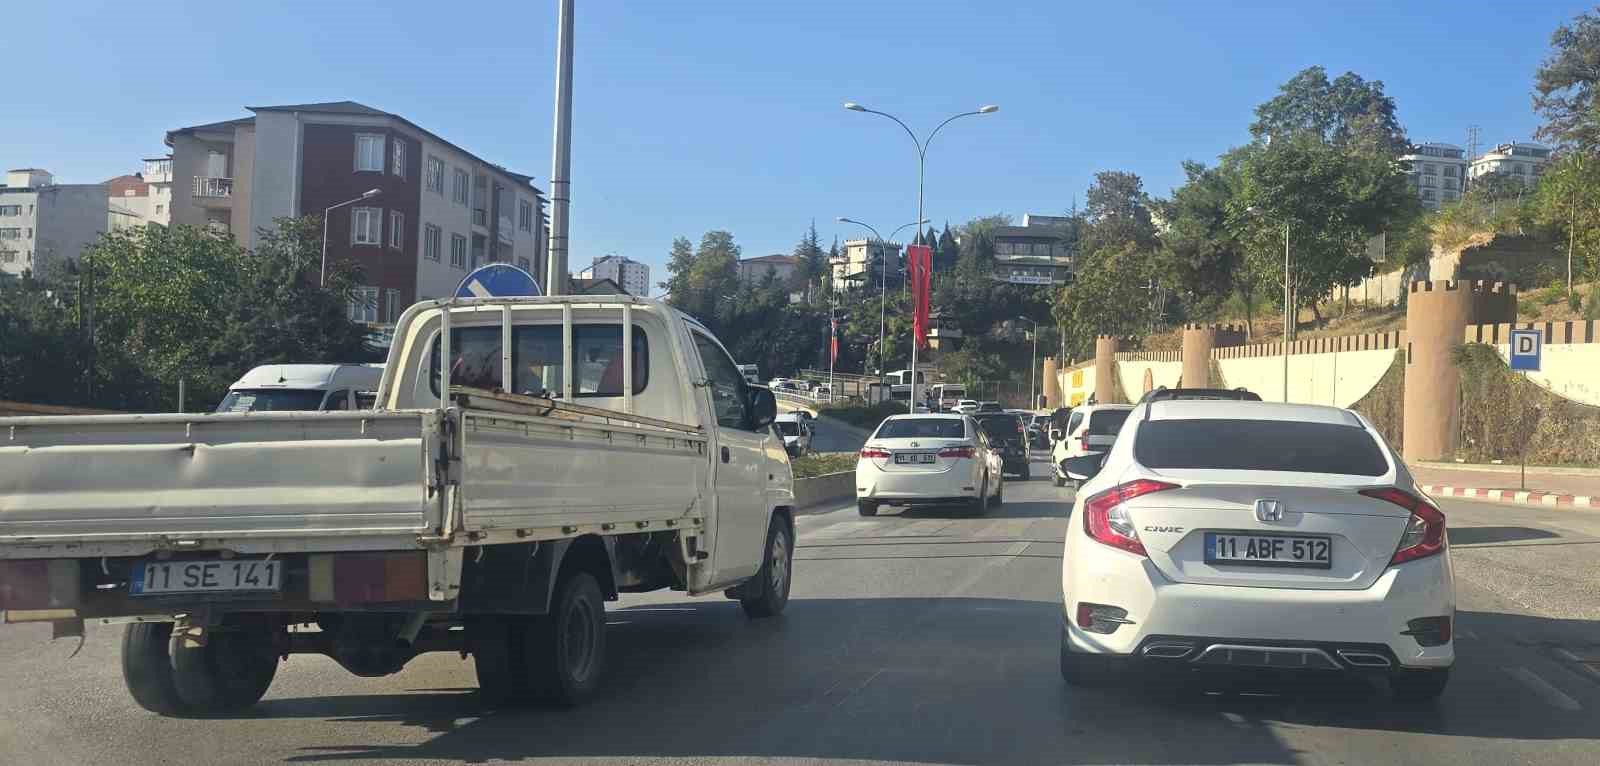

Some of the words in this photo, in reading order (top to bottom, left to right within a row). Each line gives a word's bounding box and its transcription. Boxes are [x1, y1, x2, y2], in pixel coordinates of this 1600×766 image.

[1520, 337, 1532, 353] D
[1143, 525, 1185, 533] CIVIC
[1217, 537, 1237, 558] 11
[1245, 538, 1285, 559] ABF
[1292, 540, 1328, 561] 512
[147, 565, 171, 589] 11
[183, 563, 221, 587] SE
[232, 562, 275, 587] 141
